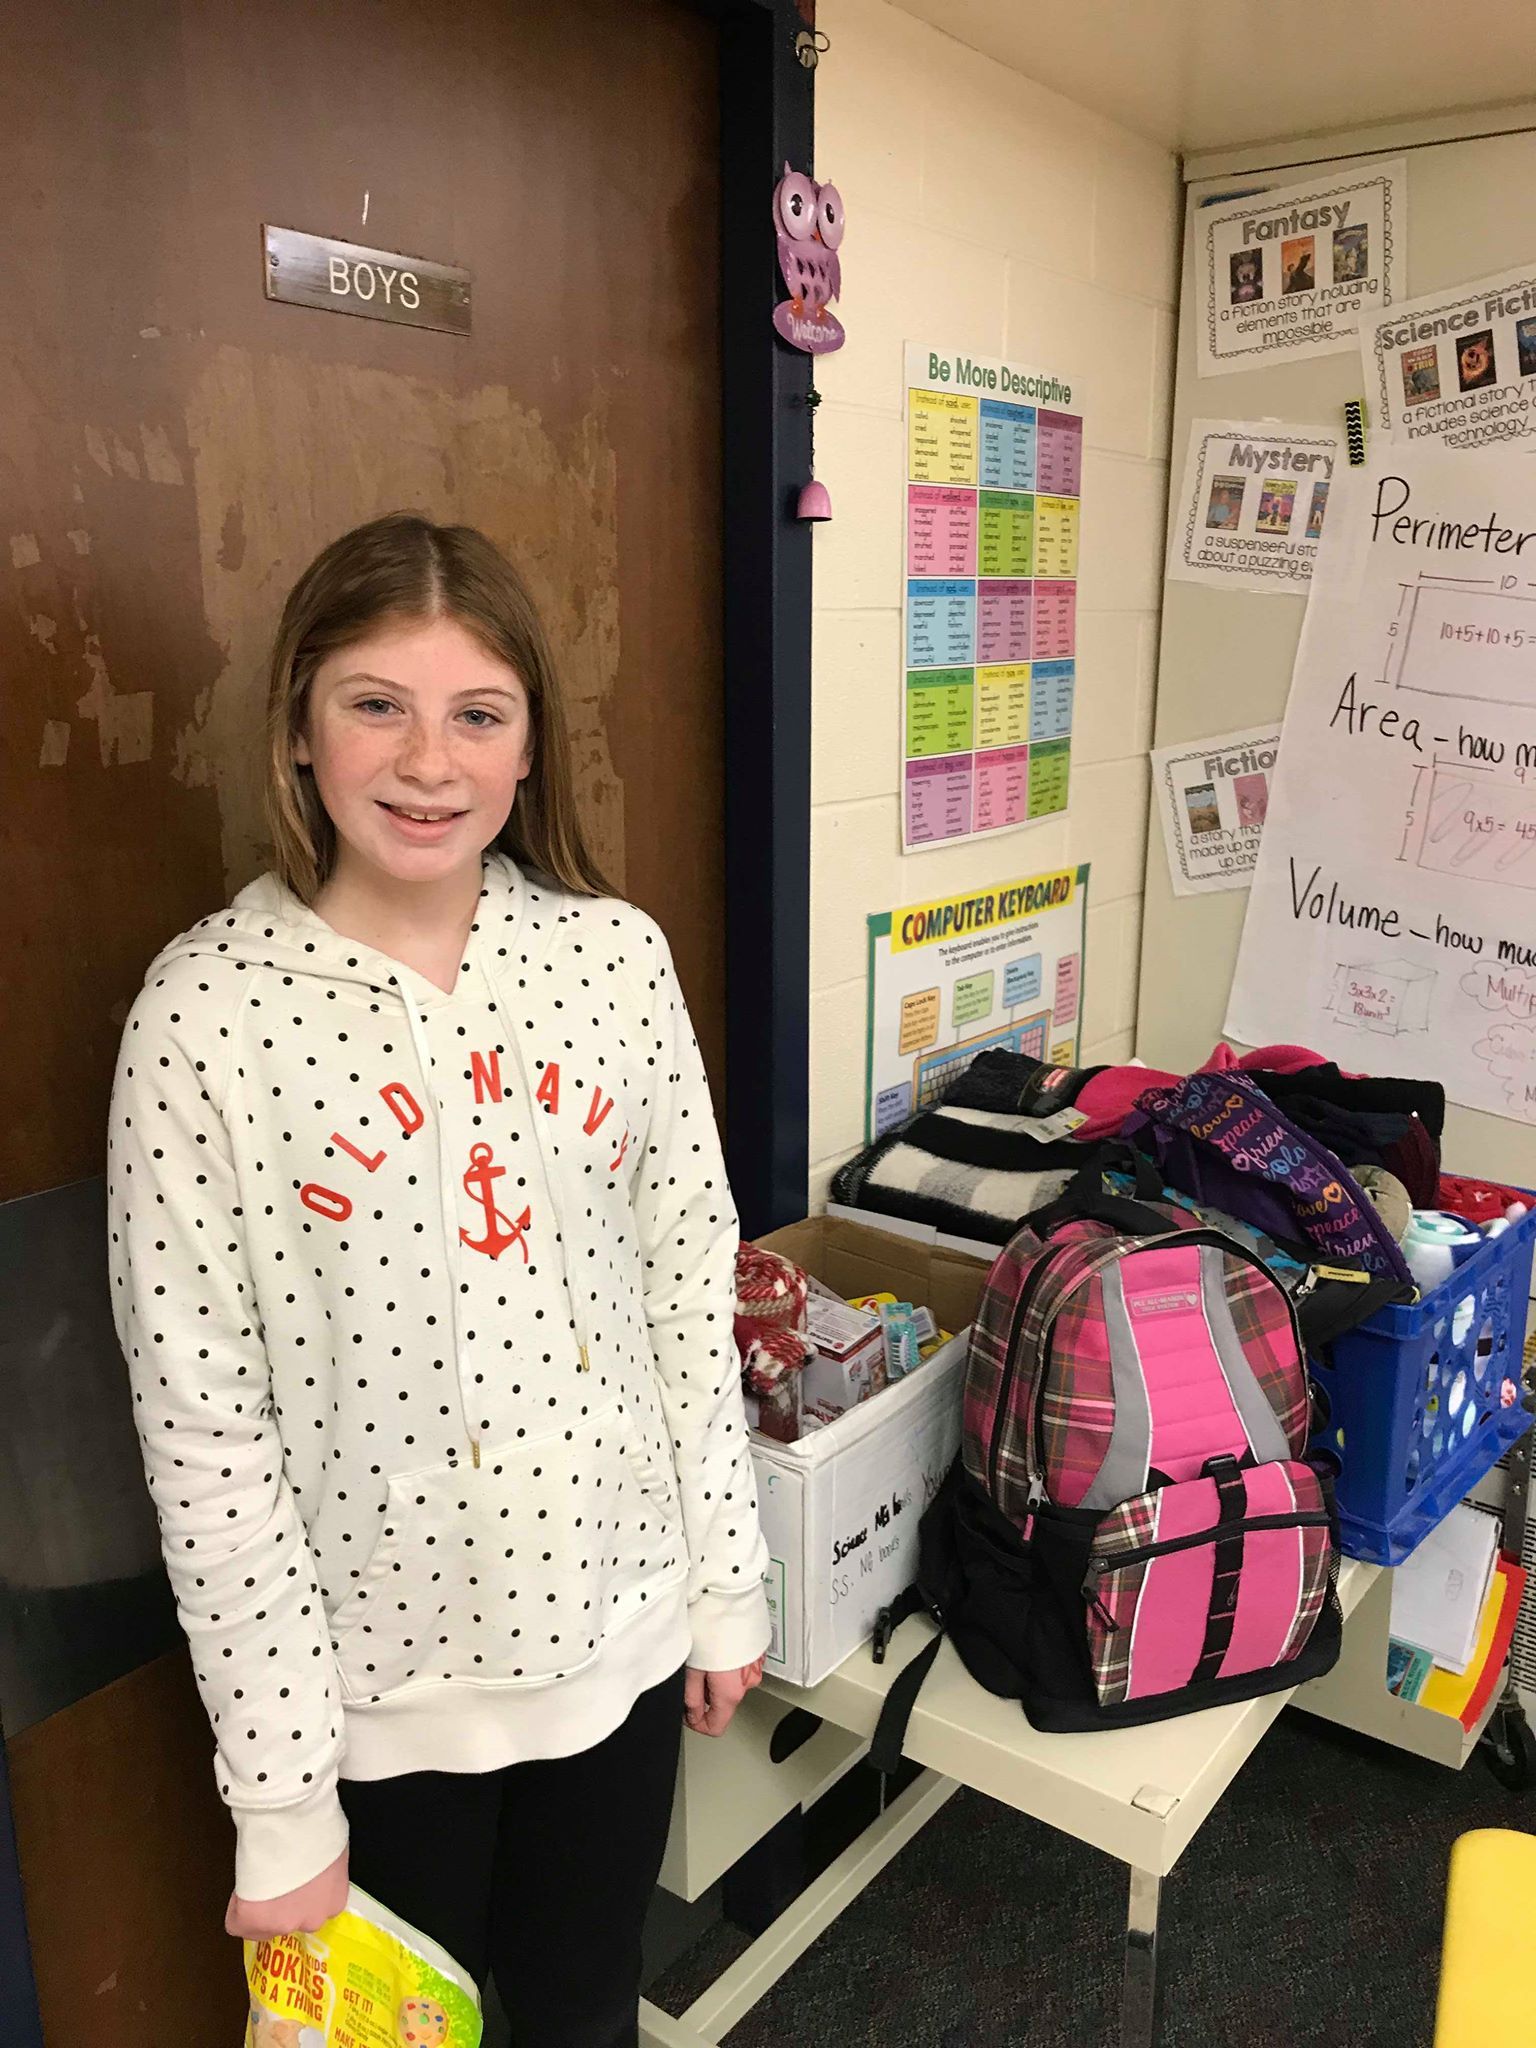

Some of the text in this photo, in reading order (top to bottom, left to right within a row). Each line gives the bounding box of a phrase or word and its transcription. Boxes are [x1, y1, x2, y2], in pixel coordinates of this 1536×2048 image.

[1242, 201, 1351, 245] Fantasy
[329, 257, 420, 309] BOYS
[1220, 278, 1378, 321] a fiction story including
[787, 313, 838, 343] Welcome
[1236, 299, 1361, 334] elements that are
[1263, 319, 1334, 346] impossible
[1381, 309, 1479, 350] Science
[928, 352, 1072, 405] Be More Descriptive
[1402, 382, 1525, 424] a fictional story
[1408, 398, 1529, 439] includes science
[1442, 416, 1529, 447] technology
[1229, 443, 1335, 479] Mystery
[1371, 476, 1536, 556] Perimeter
[1197, 549, 1236, 562] about
[1238, 554, 1247, 565] a
[1248, 555, 1299, 573] puzzling
[1205, 535, 1214, 547] a
[1216, 536, 1297, 555] suspenseful
[1500, 575, 1517, 591] 10
[1387, 622, 1399, 637] 5
[1329, 672, 1423, 752] Area
[1458, 725, 1505, 764] how
[1405, 811, 1414, 826] 5
[1190, 835, 1199, 845] a
[1201, 828, 1236, 843] story
[1190, 843, 1225, 860] made
[1226, 841, 1243, 852] up
[1218, 856, 1234, 868] up
[902, 876, 1070, 946] COMPUTER KEYBOARD
[1290, 857, 1402, 938] Volume
[1436, 913, 1483, 954] how
[949, 941, 973, 956] keyboard
[952, 956, 960, 965] the
[960, 949, 984, 965] computer
[904, 994, 937, 1010] Caps Lock Key
[1190, 1107, 1231, 1140] love
[300, 1082, 424, 1222] OLD
[251, 1963, 323, 2021] IT'S A THING
[343, 1987, 360, 2006] GET
